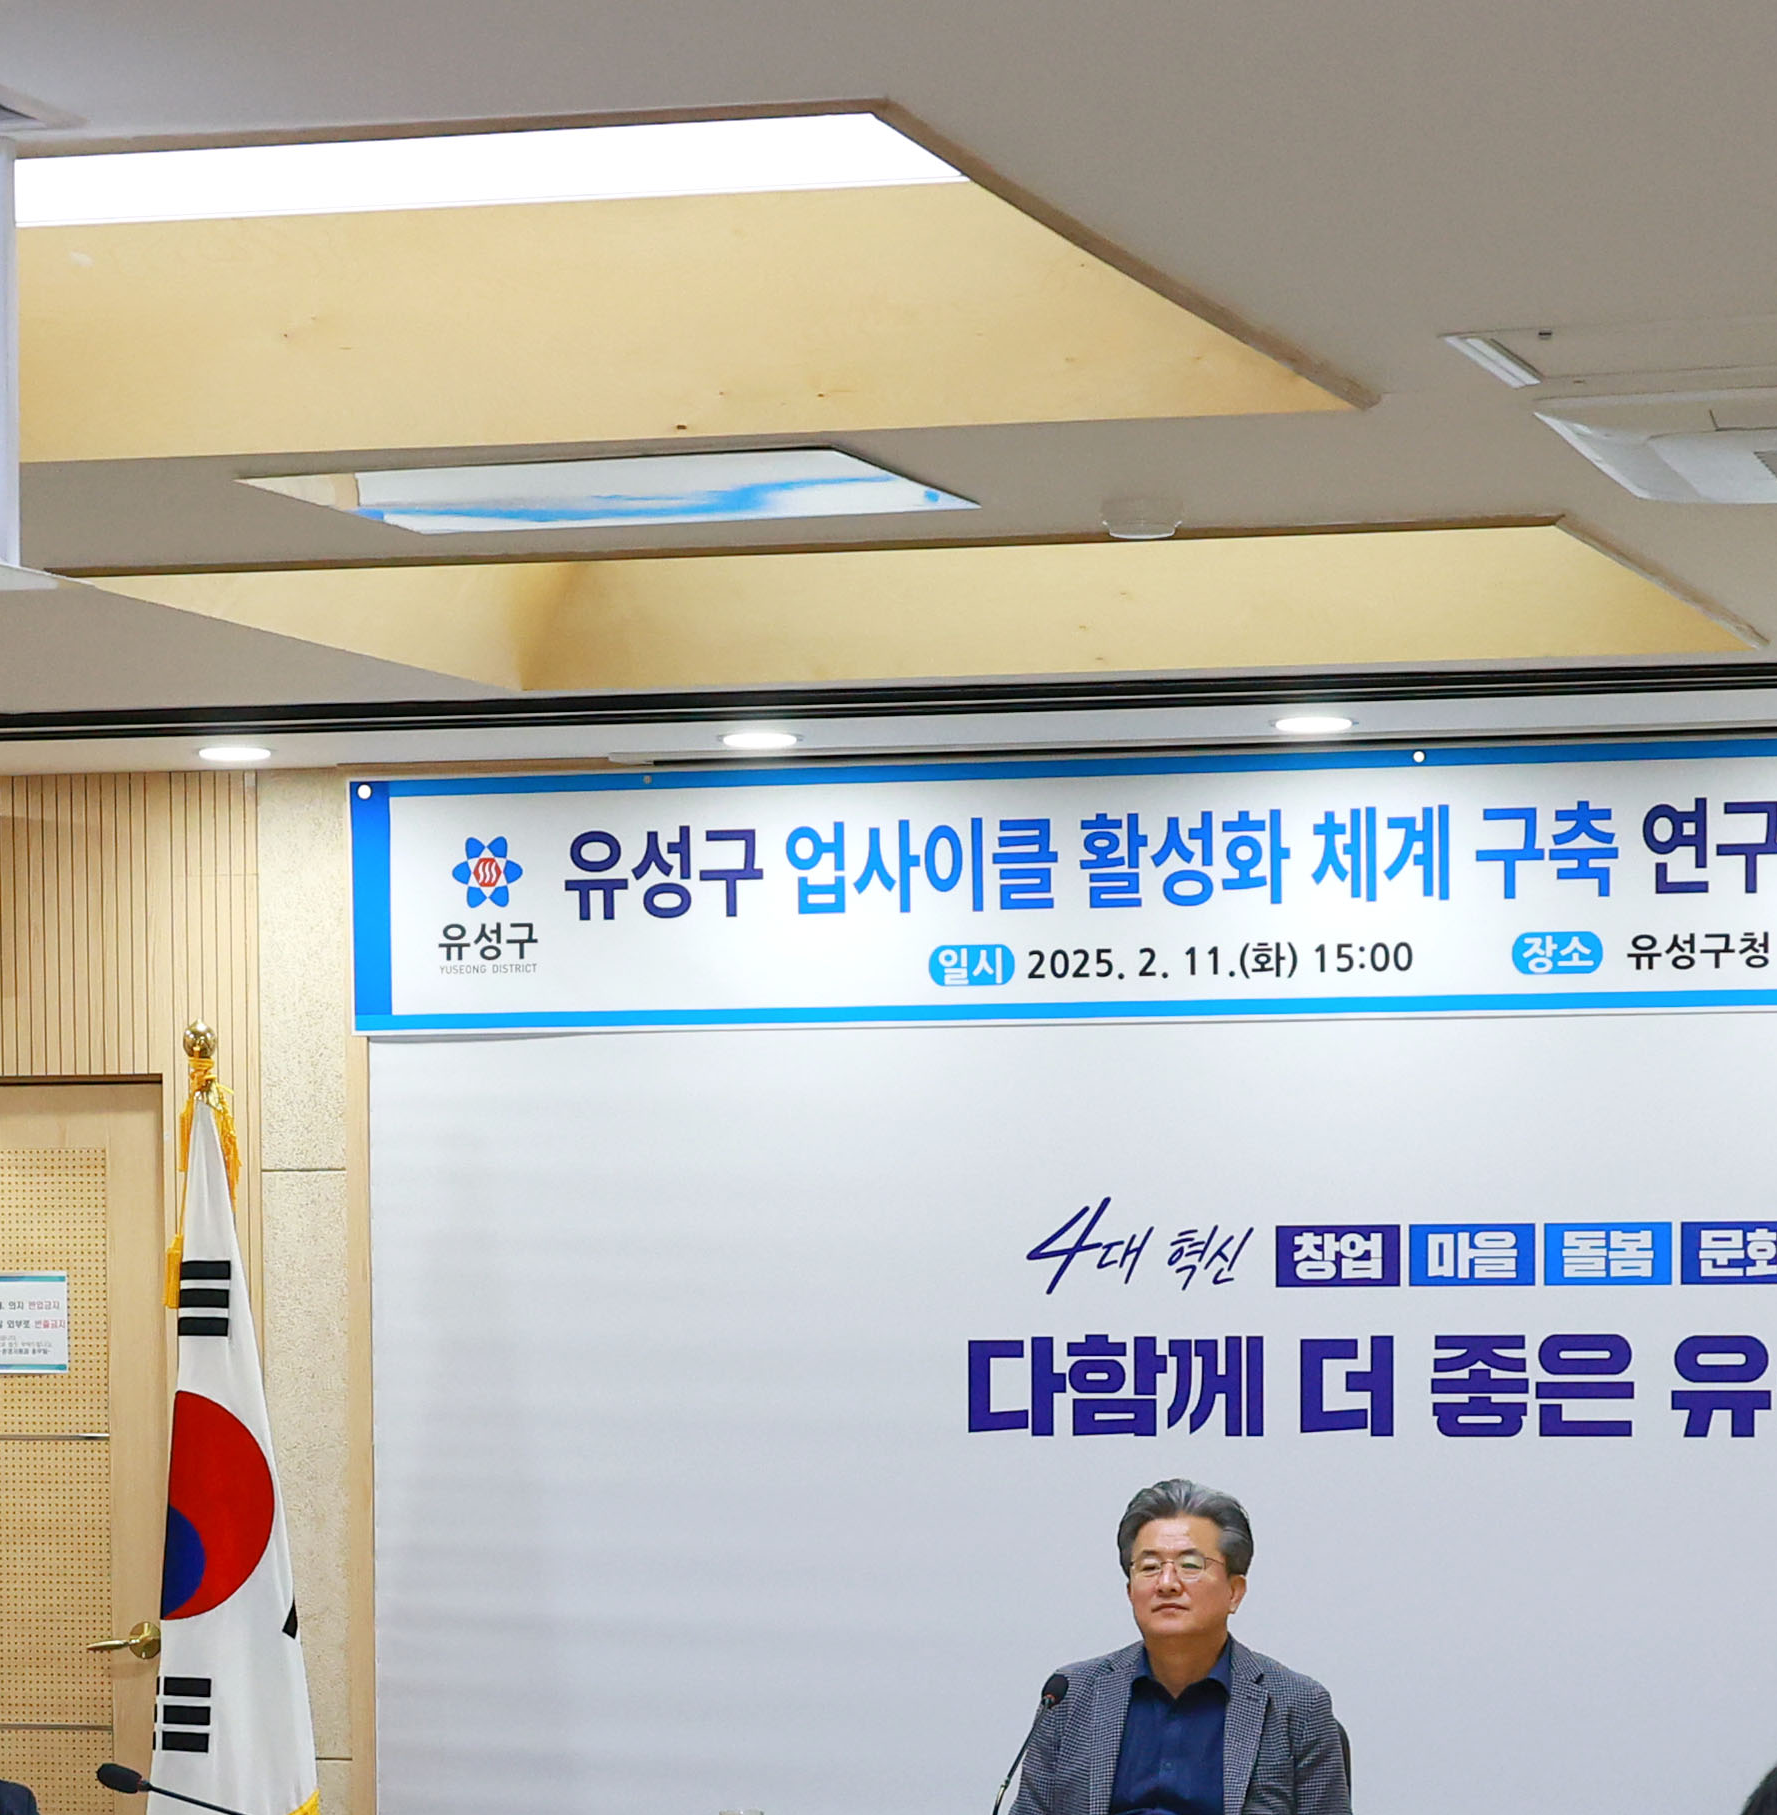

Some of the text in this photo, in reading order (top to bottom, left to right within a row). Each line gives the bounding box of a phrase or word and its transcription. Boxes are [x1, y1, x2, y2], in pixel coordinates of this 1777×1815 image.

[564, 825, 764, 921] 유성구
[786, 817, 1059, 915] 업사이클
[1079, 809, 1291, 909] 활성화
[1311, 804, 1450, 902] 체계
[1475, 800, 1619, 900] 구축
[438, 922, 539, 961] 유성구
[1027, 941, 1413, 980] 2025. 2. 11.(화) 15:00
[1522, 933, 1596, 974] 장소
[1626, 931, 1769, 971] 유성구청
[439, 962, 538, 975] YUSEONG DISTRICT
[937, 947, 1006, 986] 일시
[1167, 1224, 1254, 1291] 혁신
[1293, 1232, 1383, 1280] 창업
[1427, 1231, 1518, 1279] 마을
[1562, 1230, 1654, 1278] 돌봄
[967, 1333, 1264, 1437] 다함께
[1299, 1335, 1394, 1437] 더
[1430, 1333, 1635, 1438] 좋은
